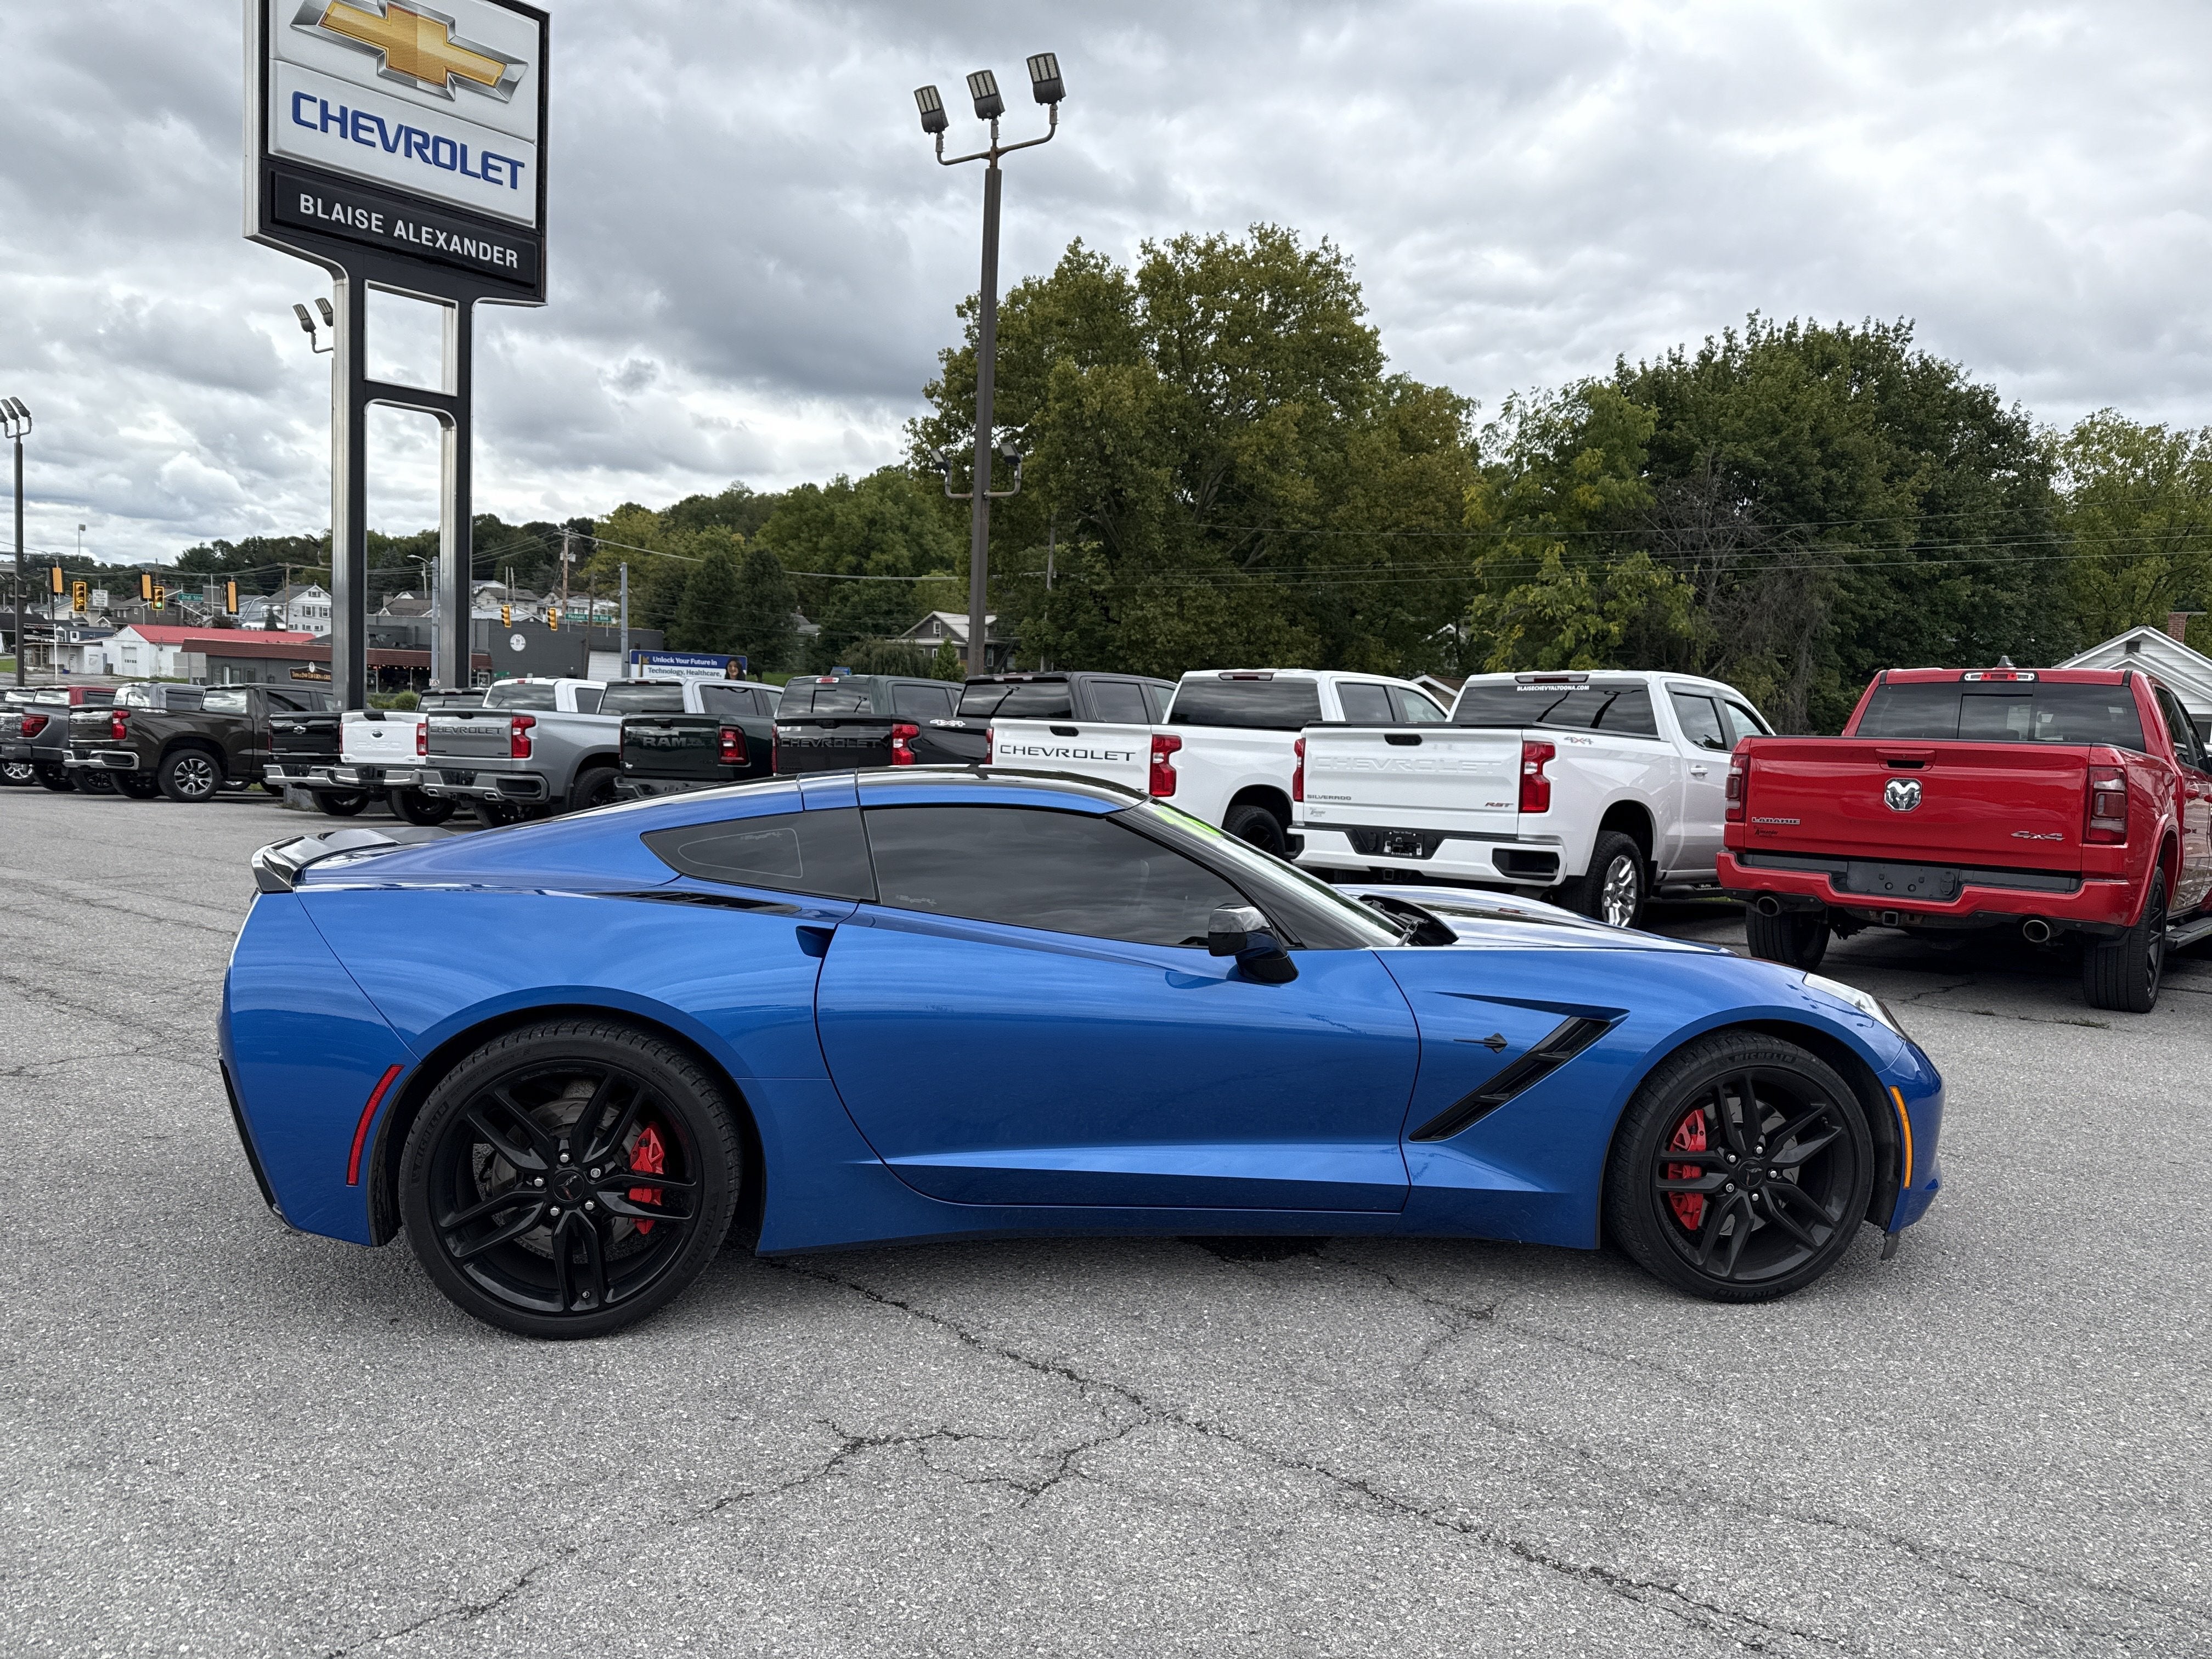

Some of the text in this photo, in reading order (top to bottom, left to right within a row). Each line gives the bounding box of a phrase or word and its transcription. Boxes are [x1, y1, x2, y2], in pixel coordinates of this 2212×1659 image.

[292, 91, 525, 190] CHEVROLET
[300, 193, 518, 269] BLAISE ALEXANDER
[648, 667, 722, 678] Technology, Healthcare,
[430, 726, 504, 735] CHEVROLET
[642, 737, 687, 747] RAM
[781, 737, 882, 748] CHEVROLET
[1000, 744, 1136, 761] CHEVROLET
[1314, 757, 1502, 775] CHEVROLET
[1751, 816, 1801, 825] LARAMIE
[1734, 1052, 1793, 1064] MICHELIN
[464, 1071, 480, 1086] SPORT
[481, 1065, 491, 1074] ALL
[492, 1054, 515, 1067] SEASON
[413, 1099, 449, 1167] MICHELIN
